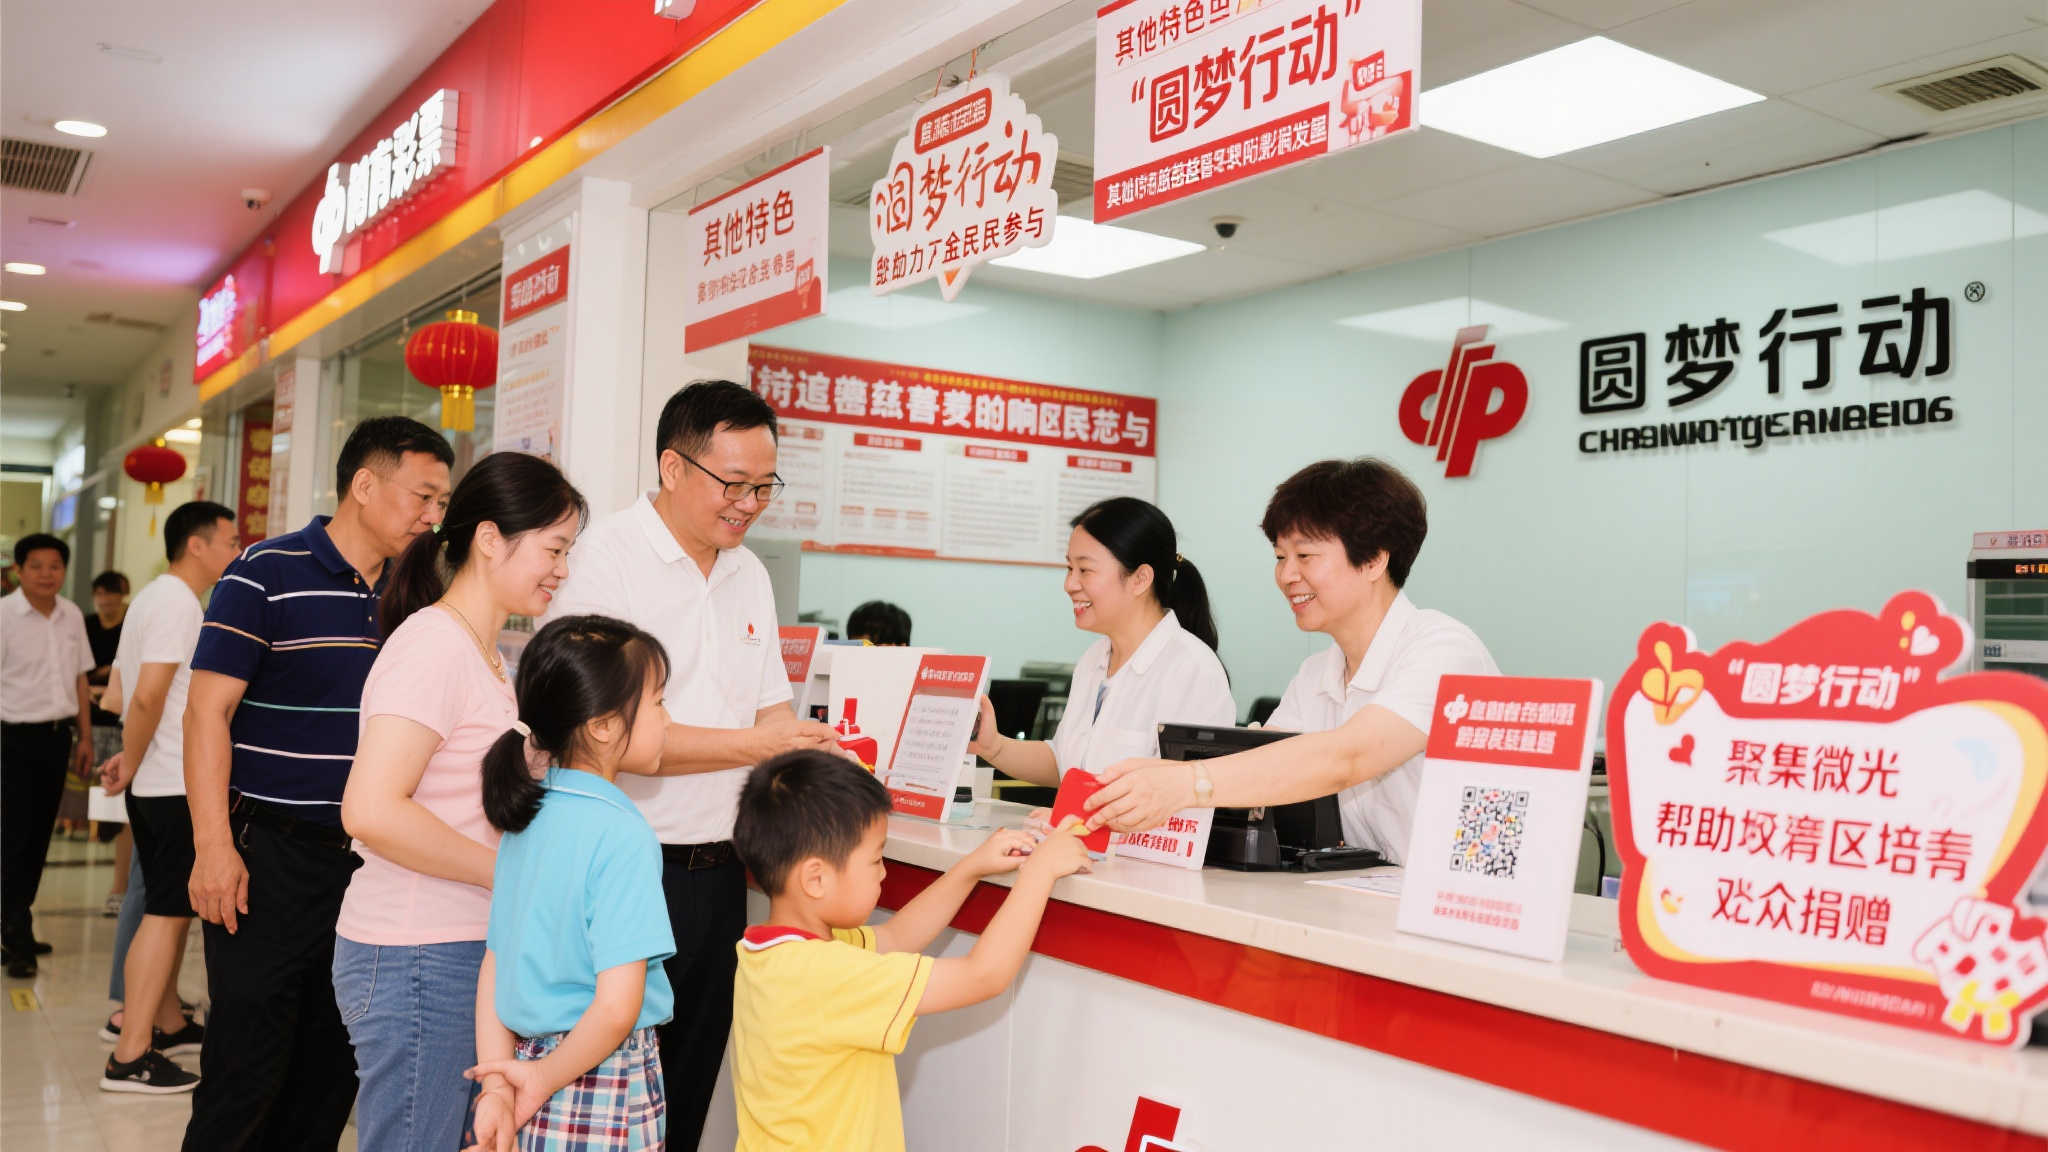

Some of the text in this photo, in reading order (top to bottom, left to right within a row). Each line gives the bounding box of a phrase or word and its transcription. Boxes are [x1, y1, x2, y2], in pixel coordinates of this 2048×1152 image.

[703, 188, 795, 267] 其他特色
[1579, 287, 1950, 415] 圆梦行动
[1727, 658, 1921, 711] “圆梦行动”
[1725, 740, 1901, 799] 聚集微光
